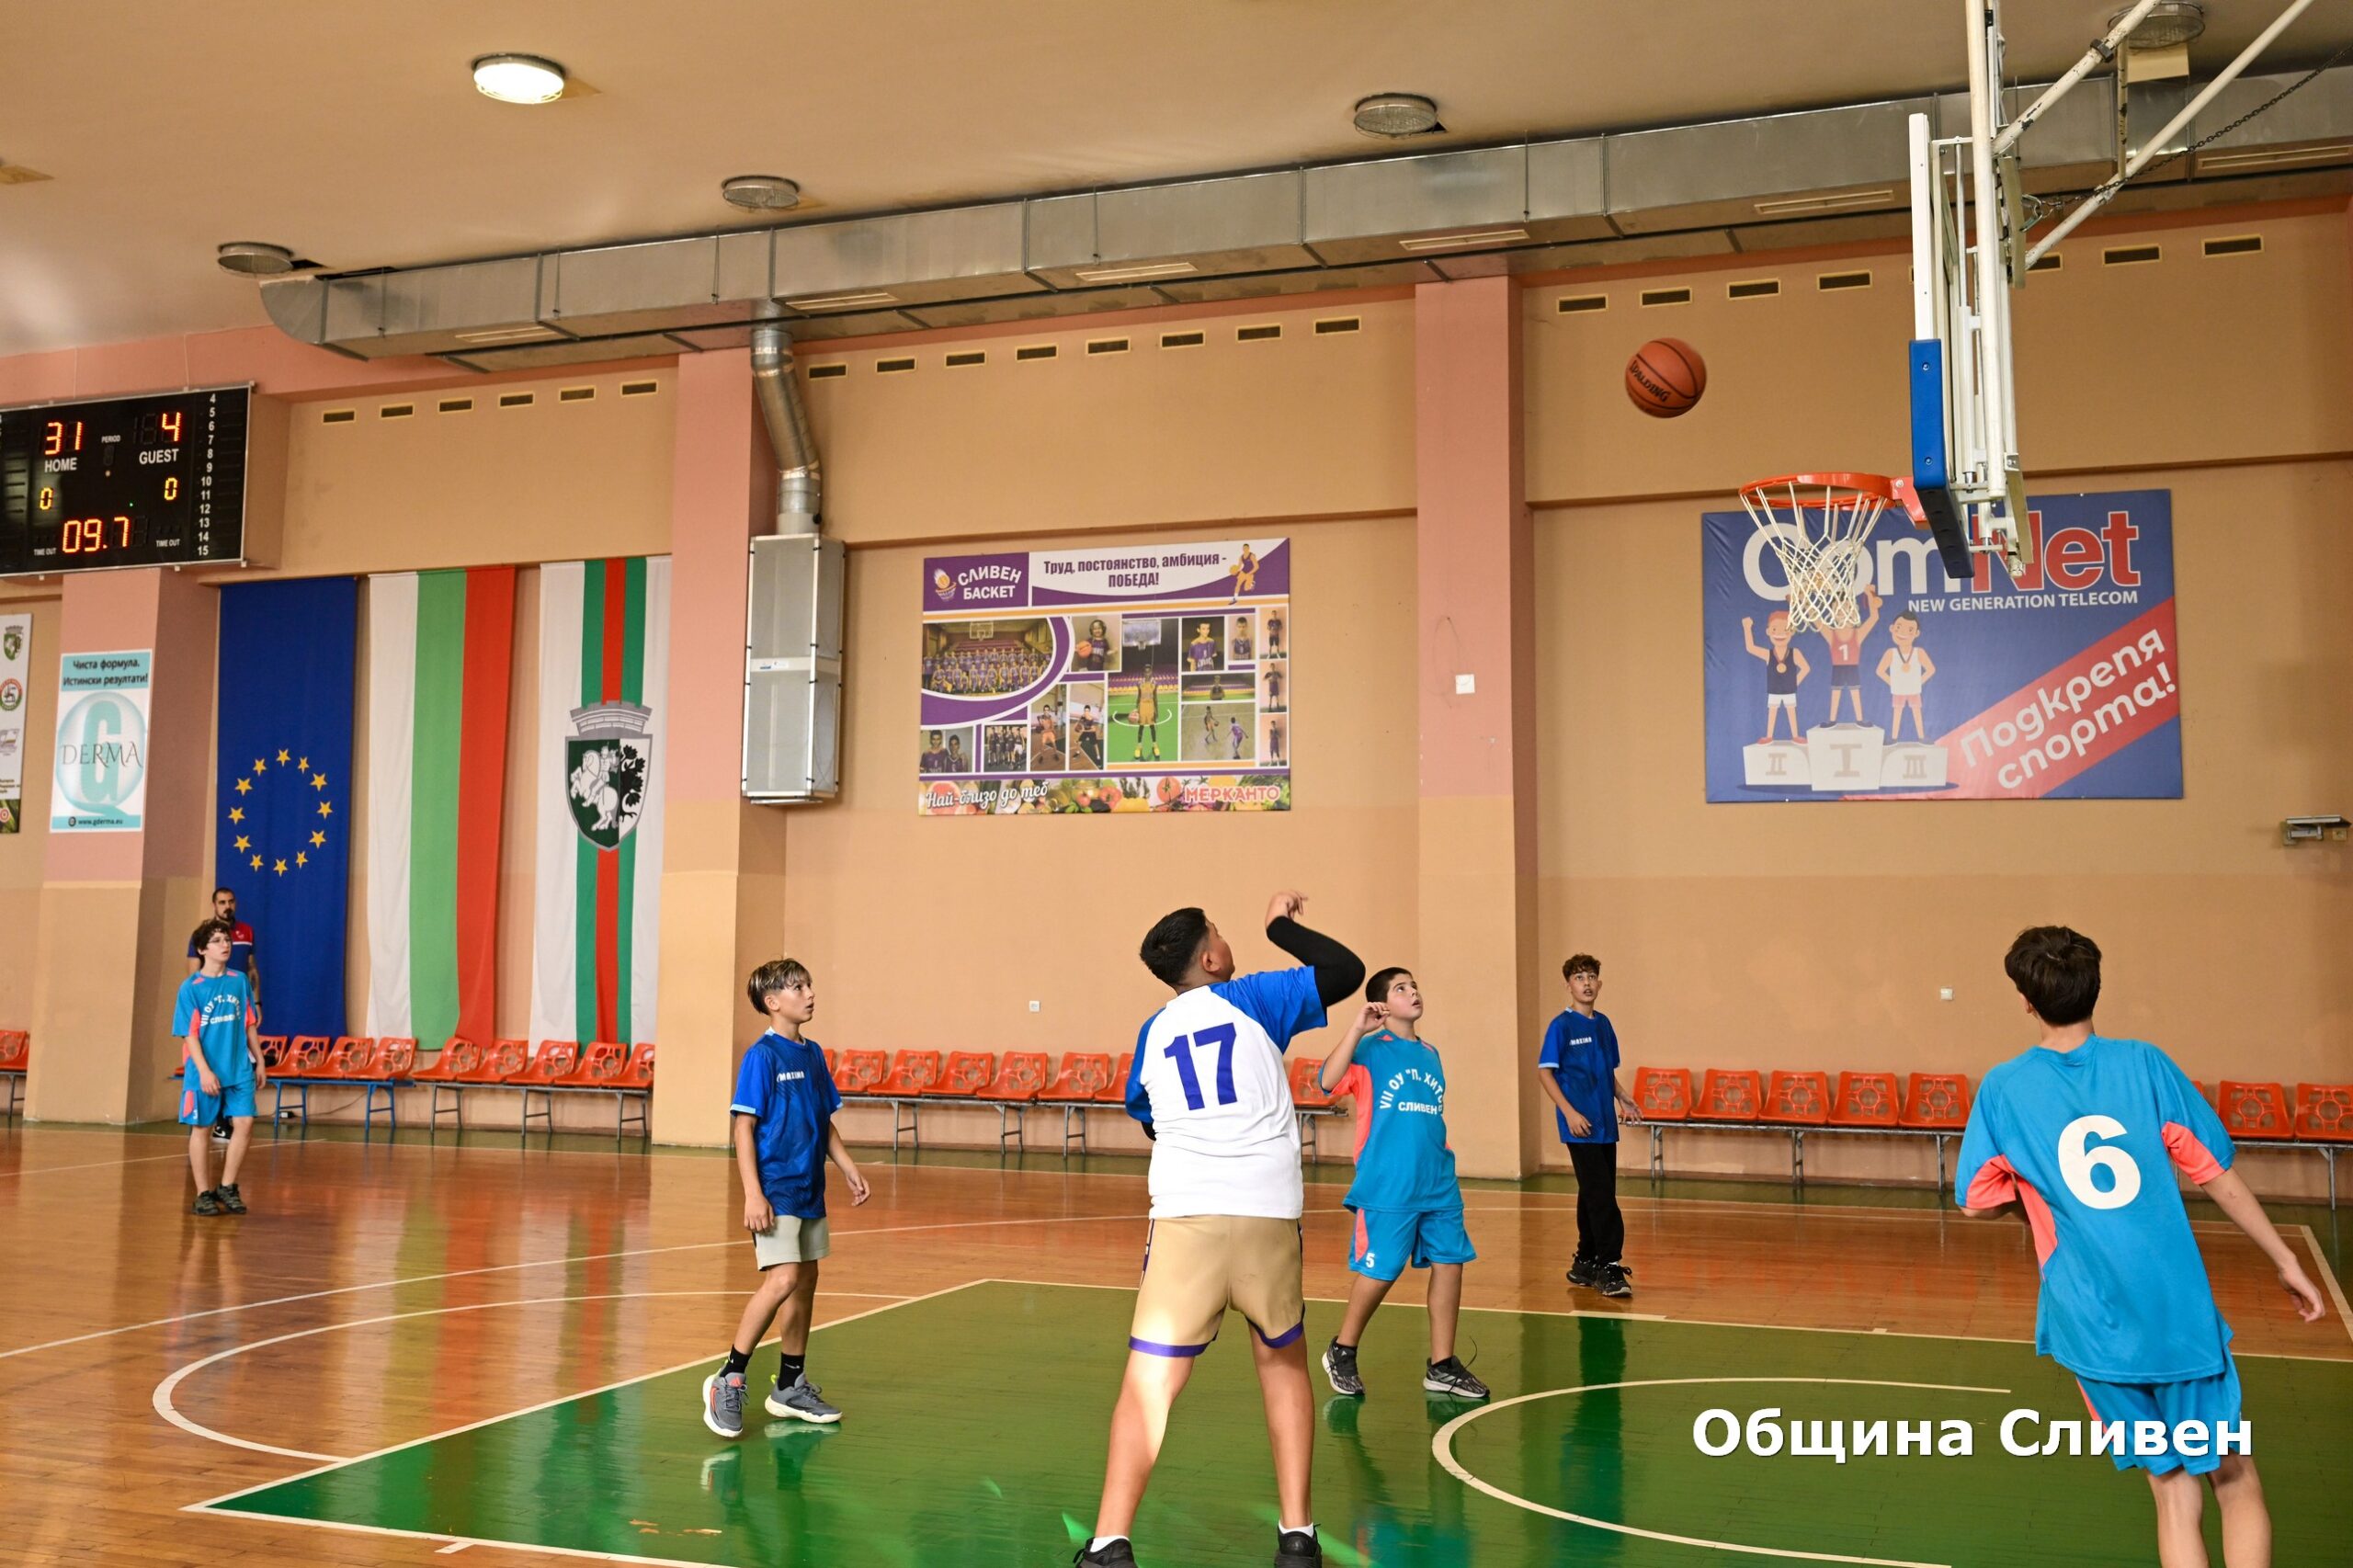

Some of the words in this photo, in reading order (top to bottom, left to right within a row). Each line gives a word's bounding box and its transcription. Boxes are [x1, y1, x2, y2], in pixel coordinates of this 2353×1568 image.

[210, 393, 216, 403] 4
[209, 407, 216, 417] 5
[161, 412, 181, 442] 4
[208, 421, 215, 431] 6
[44, 421, 83, 455] 31
[101, 434, 120, 444] PERIOD
[208, 435, 214, 445] 7
[139, 449, 179, 465] GUEST
[207, 449, 213, 459] 8
[44, 458, 77, 473] HOME
[206, 462, 212, 472] 9
[165, 477, 178, 500] 0
[201, 476, 212, 486] 10
[40, 487, 53, 510] 0
[200, 490, 211, 500] 11
[199, 504, 210, 514] 12
[199, 517, 210, 528] 13
[169, 539, 180, 547] OUT
[198, 531, 210, 542] 14
[34, 548, 45, 556] TIME
[198, 545, 210, 556] 15
[1044, 561, 1075, 574] Труд,
[1077, 557, 1160, 572] постоянство,
[1162, 553, 1220, 567] амбиция
[958, 565, 1022, 586] СЛИВЕН
[1108, 572, 1159, 588] ПОБЕДА!
[963, 585, 1016, 600] БАСКЕТ
[1908, 598, 1946, 613] NEW
[1949, 595, 2055, 612] GENERATION
[2059, 590, 2138, 606] TELECOM
[1838, 644, 1849, 661] 1
[73, 659, 98, 669] Чиста
[63, 676, 102, 687] Истински
[103, 674, 148, 687] резултати!
[61, 741, 143, 768] DERMA
[1829, 744, 1862, 778] I
[1765, 753, 1788, 776] II
[1902, 755, 1927, 778] III
[1000, 789, 1017, 808] до
[1020, 782, 1049, 800] теб
[1184, 786, 1280, 802] МЕРКАНТО
[78, 818, 123, 826] www.gderma.eu
[1164, 1022, 1237, 1111] 17
[1380, 1090, 1394, 1109] VII
[1388, 1073, 1404, 1091] ОУ
[1398, 1101, 1438, 1115] СЛИВЕН
[2057, 1115, 2142, 1210] 6
[1366, 1254, 1375, 1267] 5
